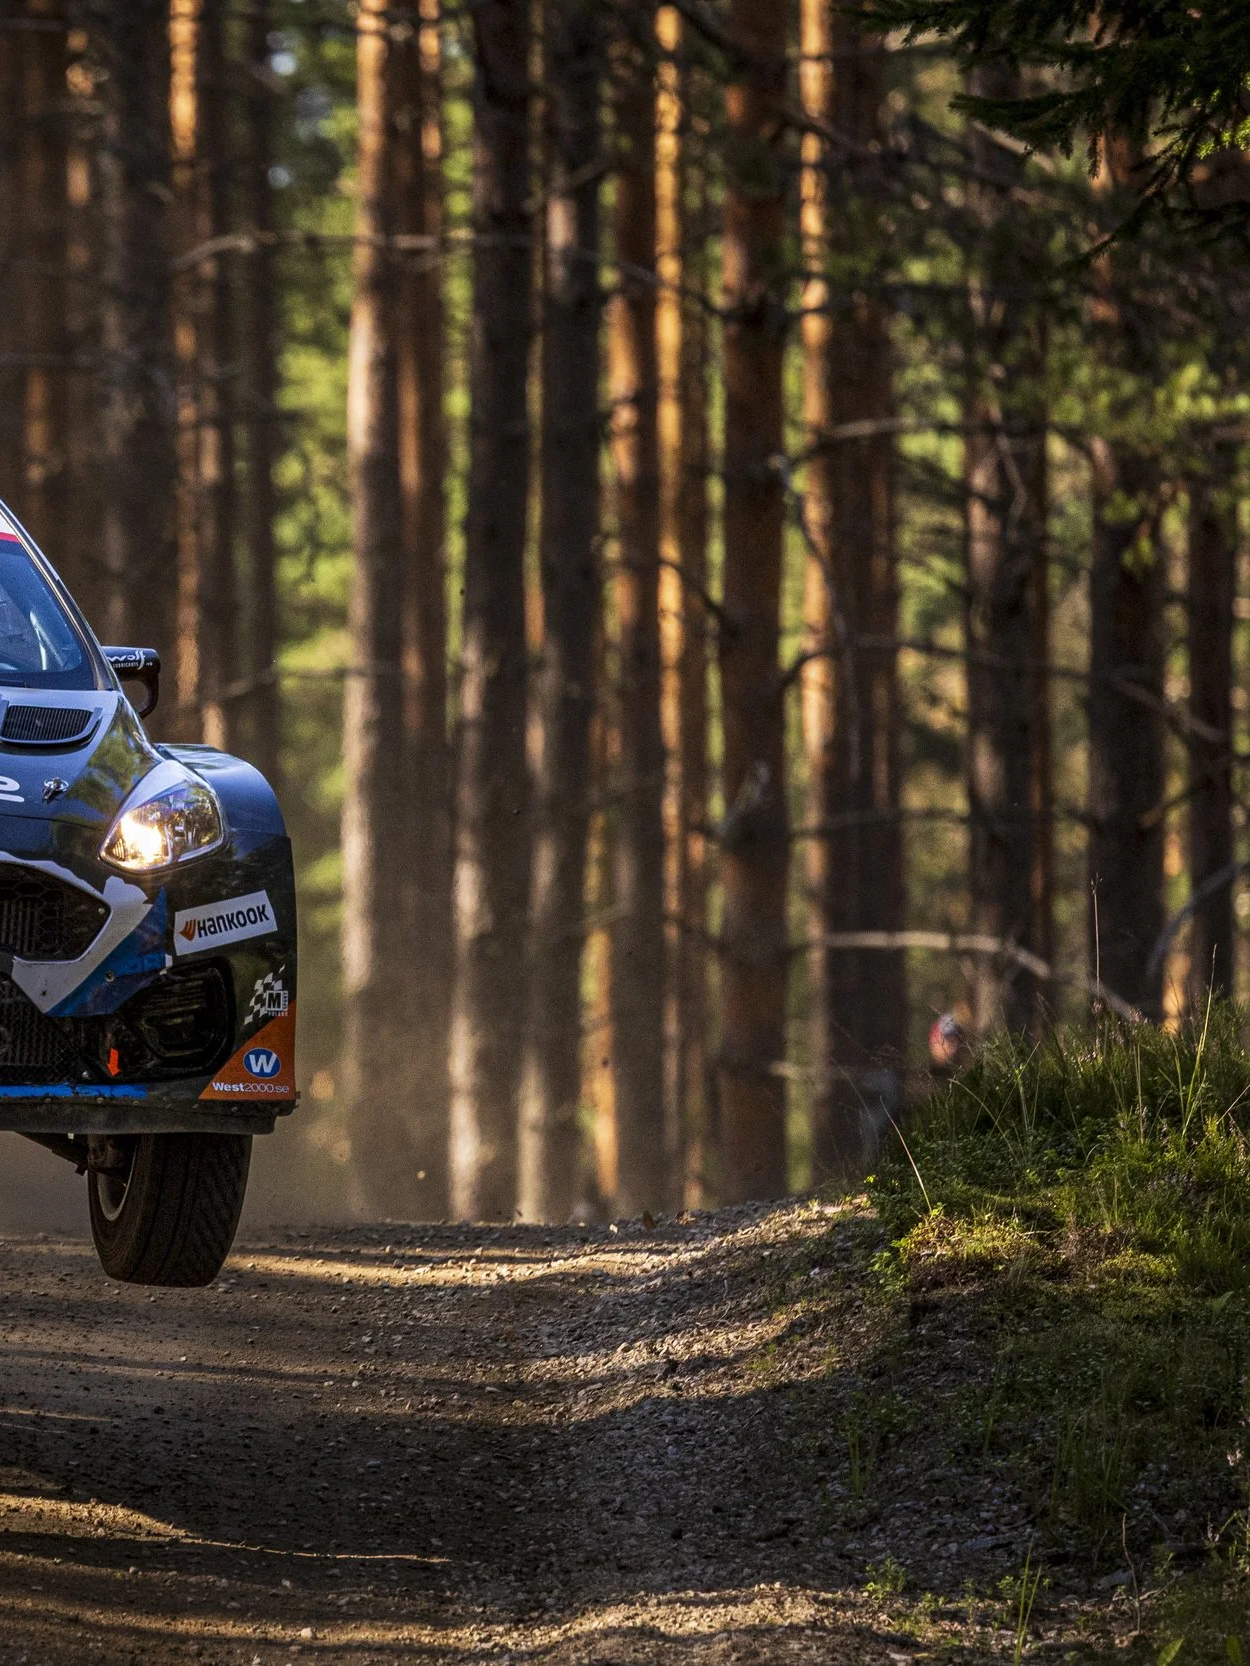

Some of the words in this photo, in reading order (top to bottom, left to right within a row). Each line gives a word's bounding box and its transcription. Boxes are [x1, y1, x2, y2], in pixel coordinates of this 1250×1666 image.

[267, 991, 282, 1010] M
[249, 1053, 278, 1074] W
[212, 1082, 290, 1094] West2000.se
